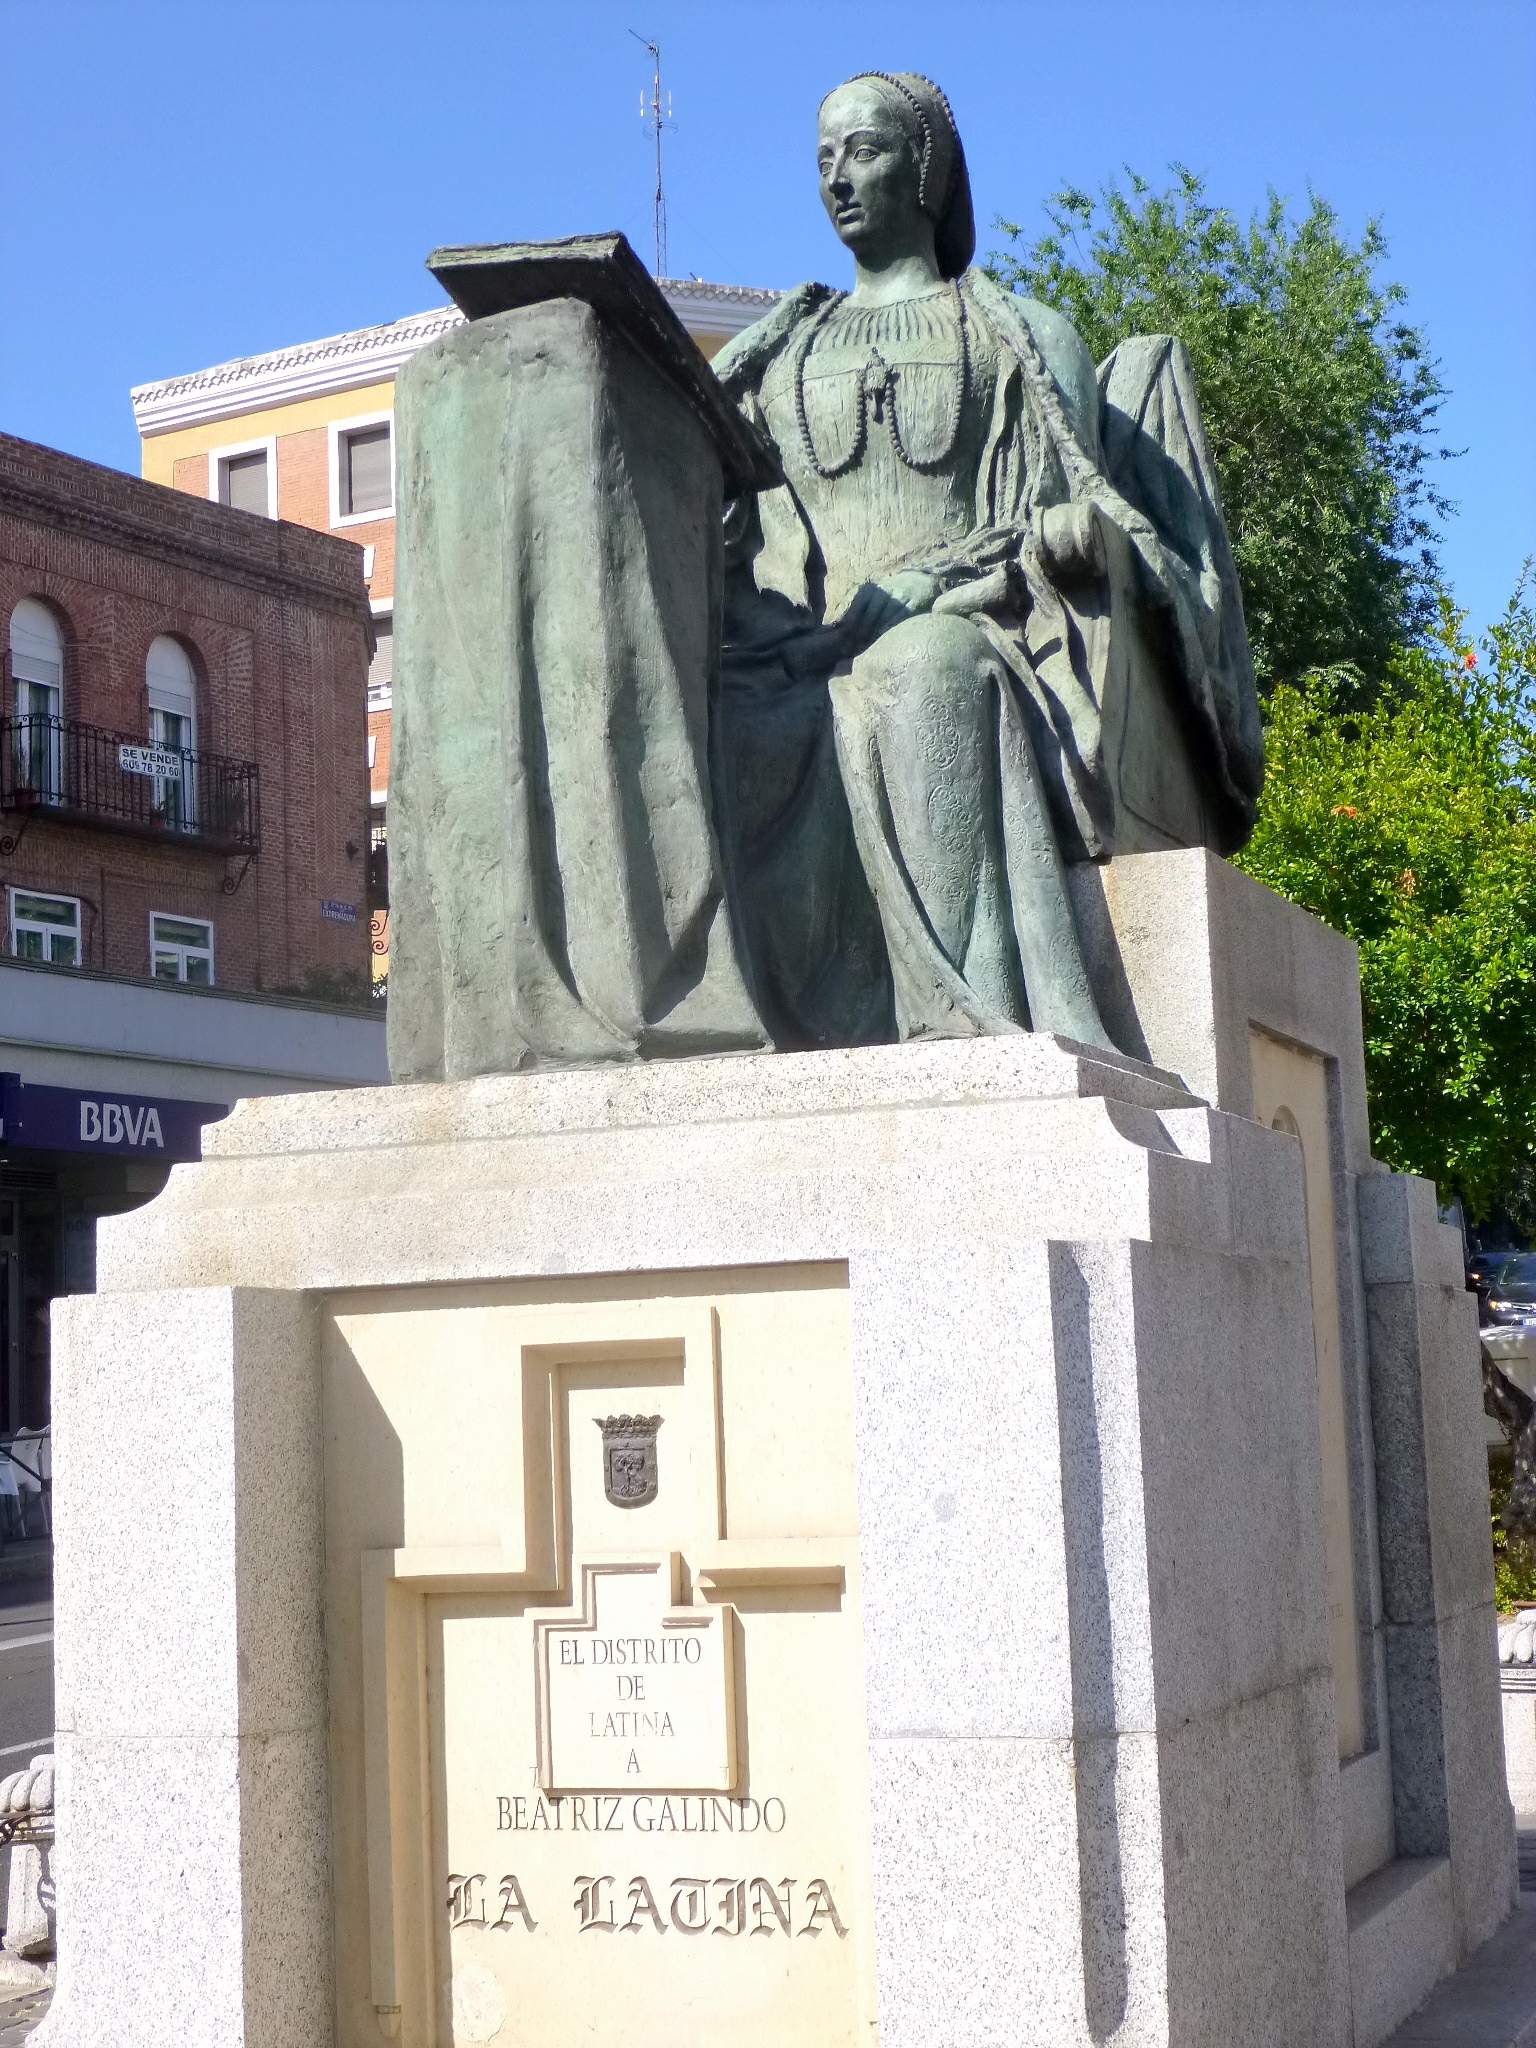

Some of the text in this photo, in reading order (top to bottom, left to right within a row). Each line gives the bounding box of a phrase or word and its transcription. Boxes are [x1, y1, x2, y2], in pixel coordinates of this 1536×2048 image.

[122, 748, 179, 766] SE VENDE
[156, 764, 167, 775] 20
[168, 766, 179, 777] 60
[80, 1100, 165, 1148] BBVA
[560, 1637, 702, 1665] EL DISTRITO
[616, 1675, 646, 1701] DE
[588, 1711, 676, 1738] LATINA
[626, 1748, 642, 1773] A
[496, 1796, 787, 1833] BEATRIZ GALINDO
[446, 1873, 850, 1940] LA LATINA
